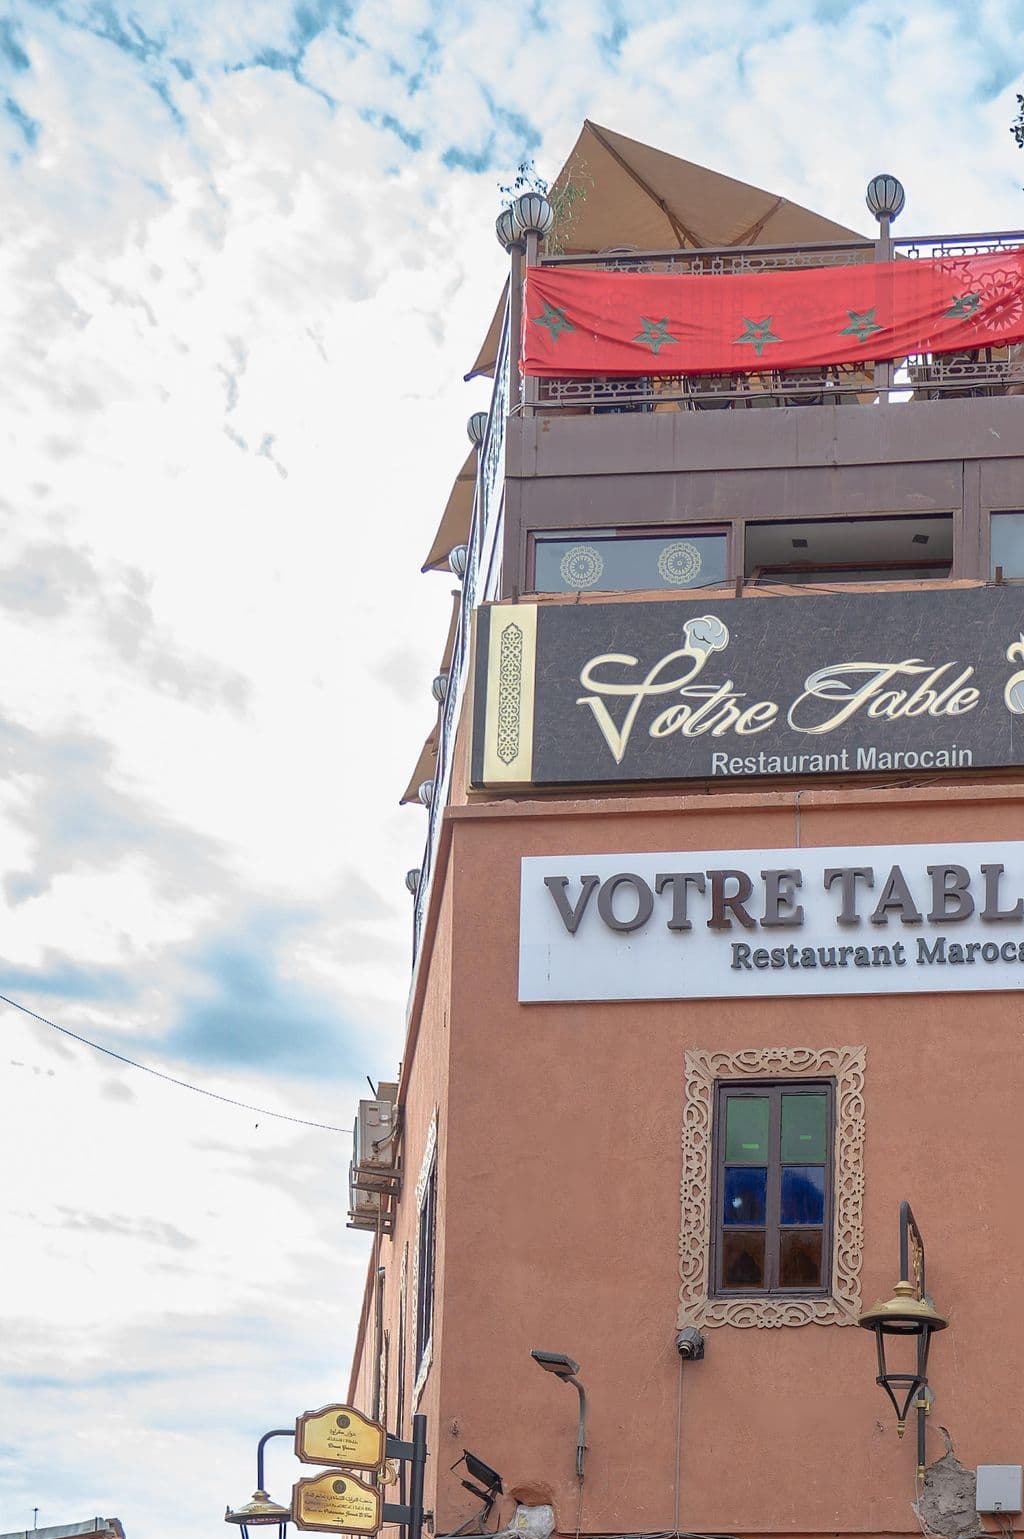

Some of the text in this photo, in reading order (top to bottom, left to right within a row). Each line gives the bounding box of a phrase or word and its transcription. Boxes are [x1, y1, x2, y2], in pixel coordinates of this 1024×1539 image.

[576, 640, 981, 765] Votre Table
[711, 744, 973, 776] Restaurant Marocain
[543, 868, 805, 933] VOTRE
[730, 941, 905, 970] Restaurant
